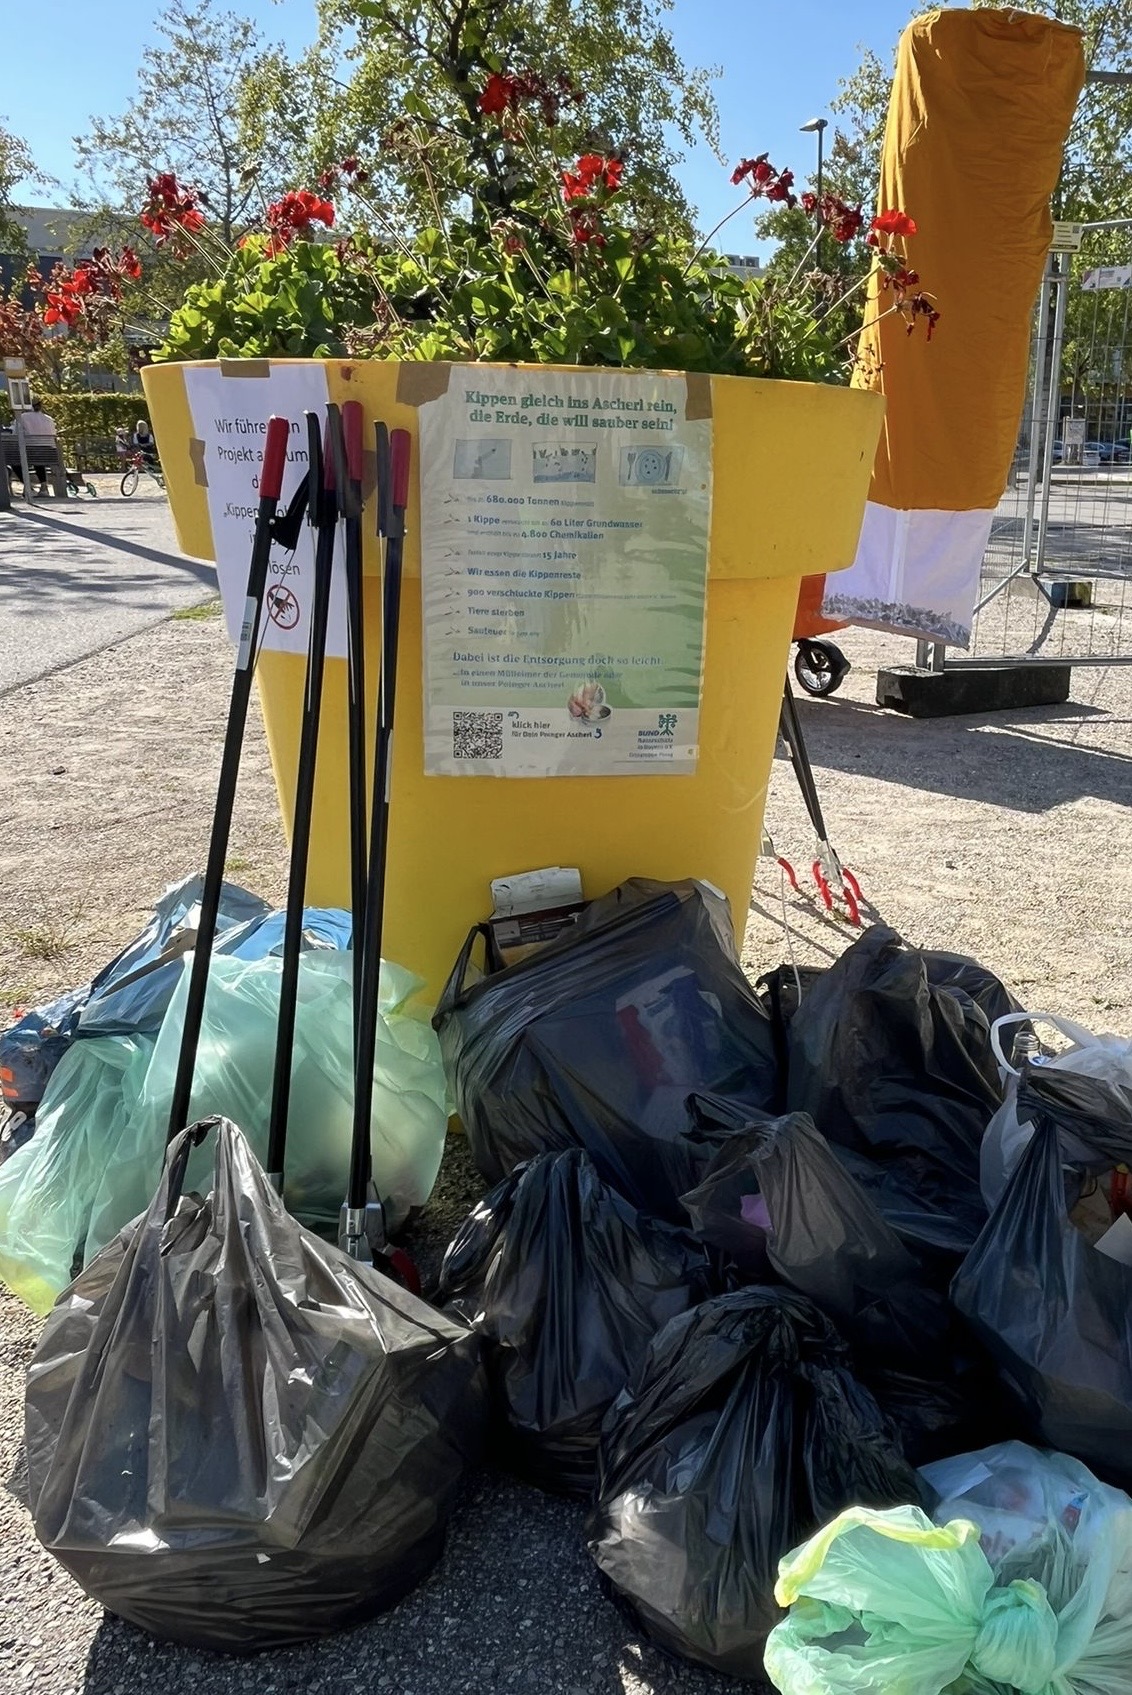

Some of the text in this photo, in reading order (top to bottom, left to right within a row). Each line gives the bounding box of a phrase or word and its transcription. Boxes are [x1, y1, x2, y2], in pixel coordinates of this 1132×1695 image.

[465, 389, 677, 414] Kippen gleich ins Ascherl rein,
[215, 418, 268, 434] Wir führe
[469, 409, 674, 431] die Erde, die will sauber sein!
[217, 446, 255, 464] Projekt
[486, 494, 525, 505] 680.000
[527, 496, 560, 507] Tonnen
[473, 514, 500, 526] Kippe
[550, 518, 562, 527] 60
[564, 518, 584, 528] Liter
[586, 519, 643, 530] Grundwasser
[521, 529, 548, 540] 4.800
[549, 530, 604, 540] Chemikalien
[542, 550, 553, 560] 15
[554, 550, 577, 560] Jahre
[268, 560, 301, 576] lösen
[467, 567, 582, 581] Wir essen die Kippenreste
[467, 588, 485, 598] 900
[487, 588, 543, 599] verschluckte
[544, 589, 576, 600] Kippen
[467, 606, 525, 617] Tiere sterben
[453, 651, 484, 662] Dabei
[487, 652, 500, 663] ist
[502, 654, 521, 664] die
[523, 654, 586, 667] Entsorgung
[587, 654, 615, 666] doch
[498, 669, 542, 678] Mülleimer
[512, 720, 551, 729] klick hier
[638, 729, 660, 737] BUND
